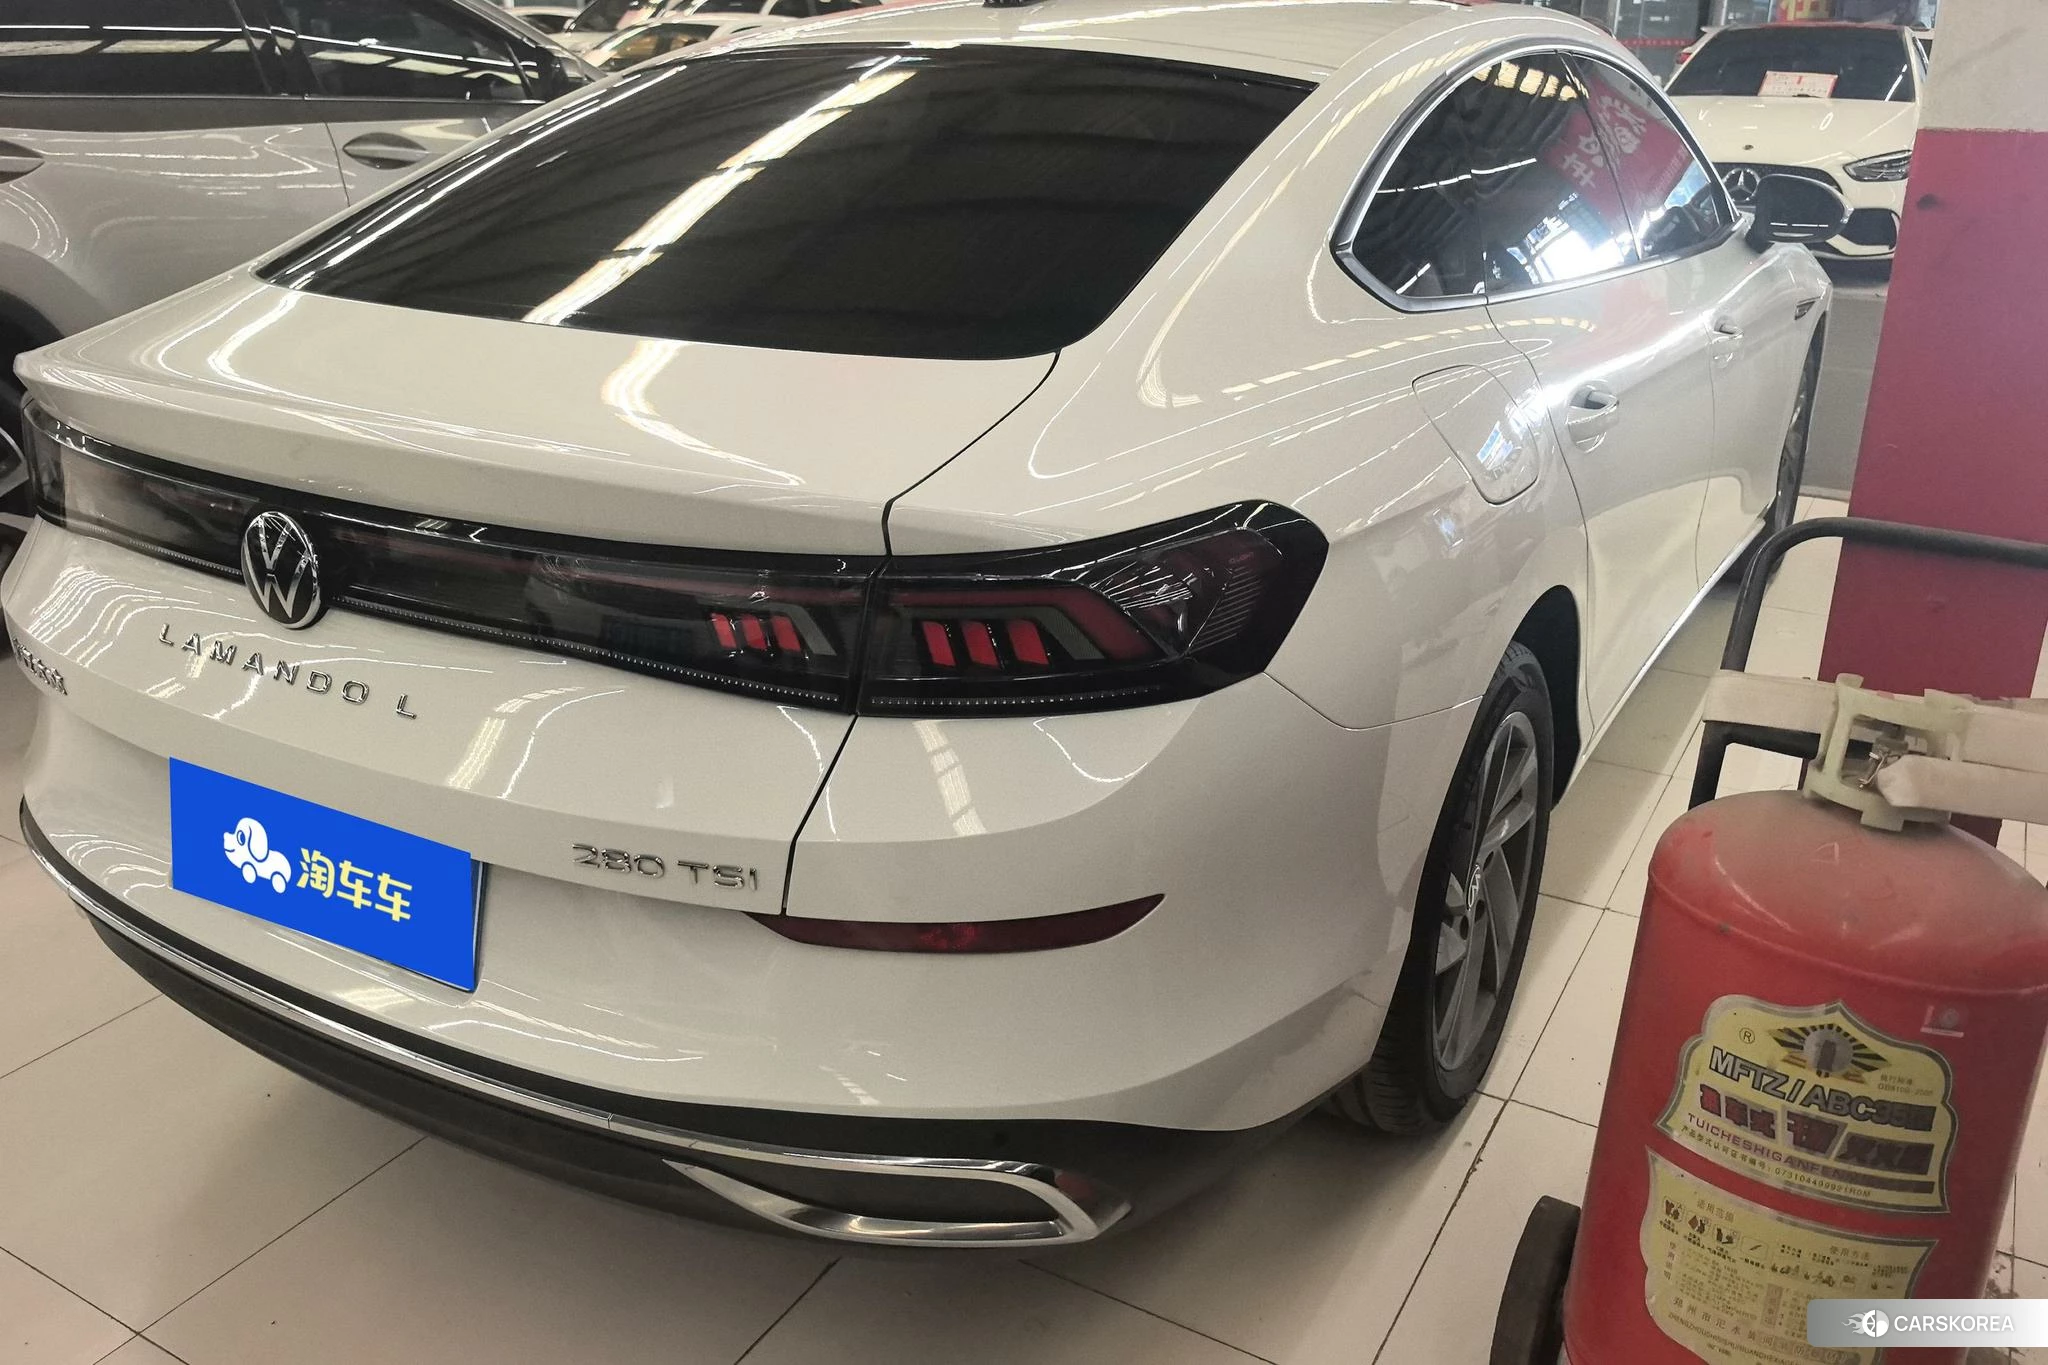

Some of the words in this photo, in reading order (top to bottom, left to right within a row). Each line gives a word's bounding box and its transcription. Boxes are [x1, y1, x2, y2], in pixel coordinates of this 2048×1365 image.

[158, 623, 370, 705] LAMANDO
[396, 693, 417, 720] L
[572, 843, 664, 878] 280
[677, 860, 758, 891] TSI
